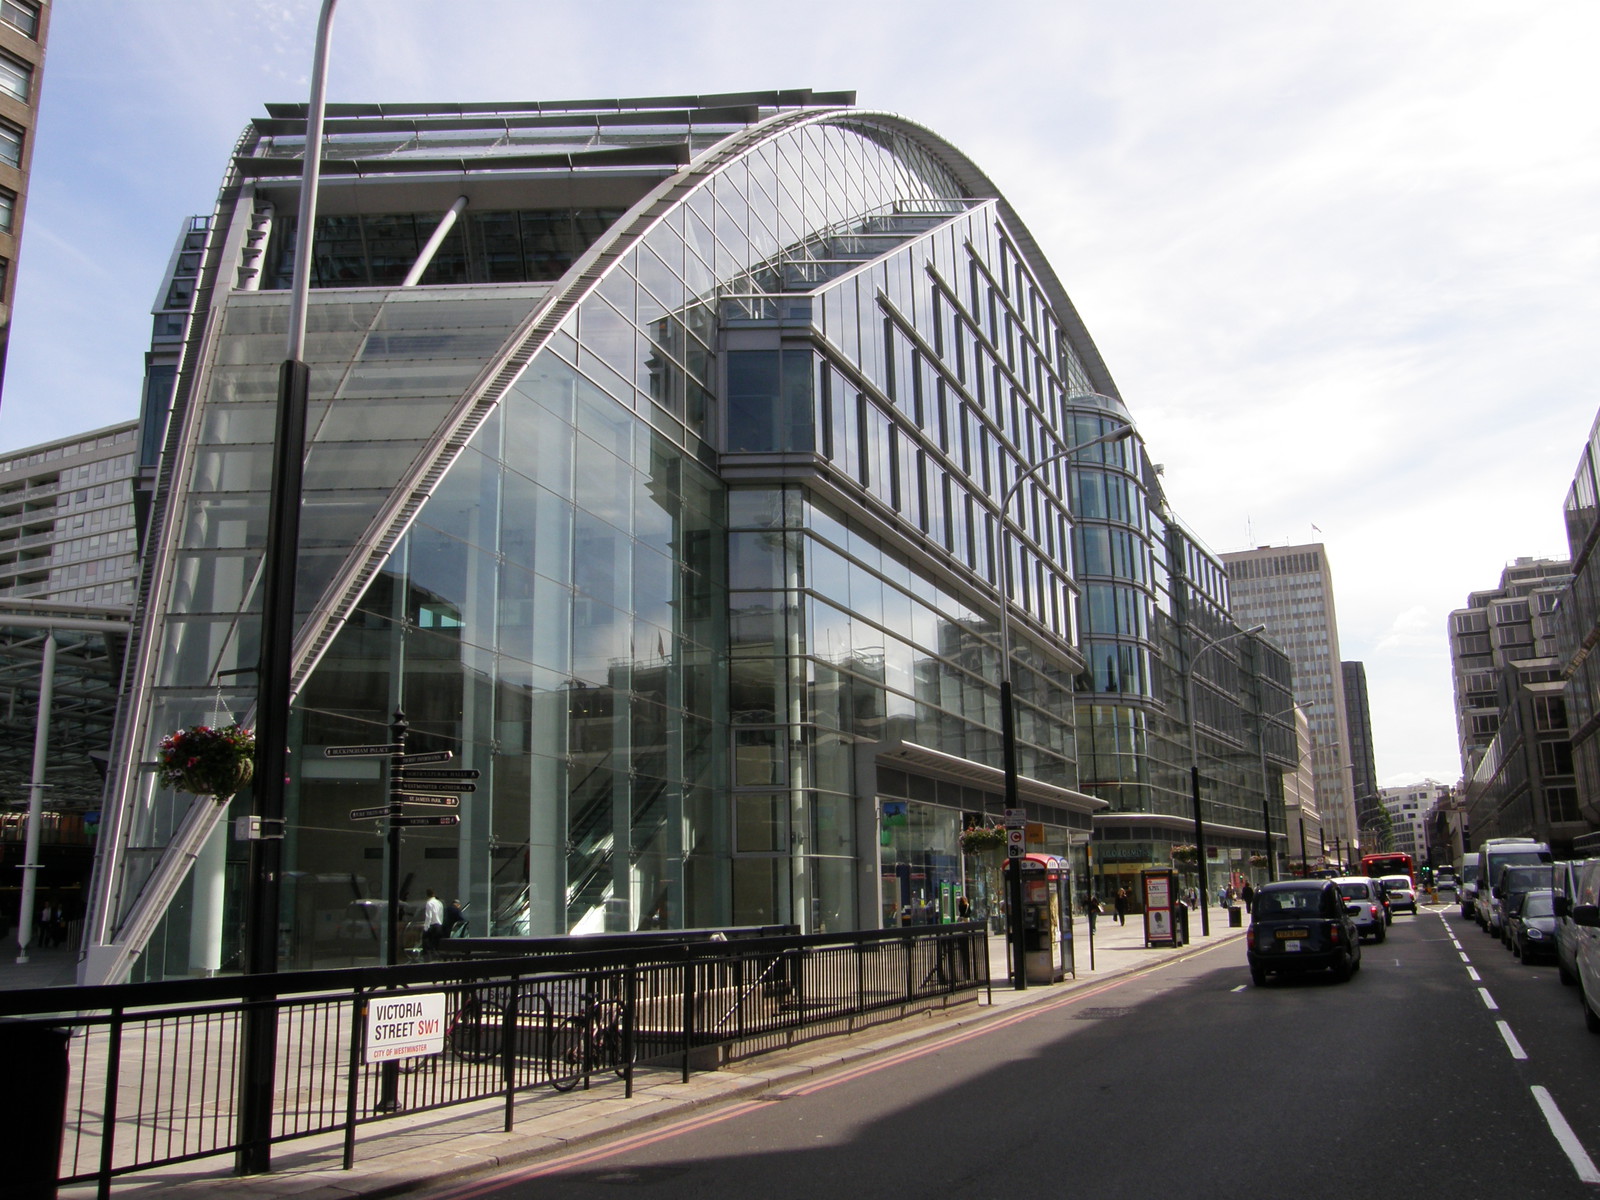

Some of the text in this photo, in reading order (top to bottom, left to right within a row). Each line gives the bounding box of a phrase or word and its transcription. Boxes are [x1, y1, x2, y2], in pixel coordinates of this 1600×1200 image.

[376, 1002, 422, 1020] VICTORIA
[375, 1019, 439, 1040] STREET SW1
[386, 1049, 392, 1057] OF
[394, 1044, 427, 1055] WESTMINSTER
